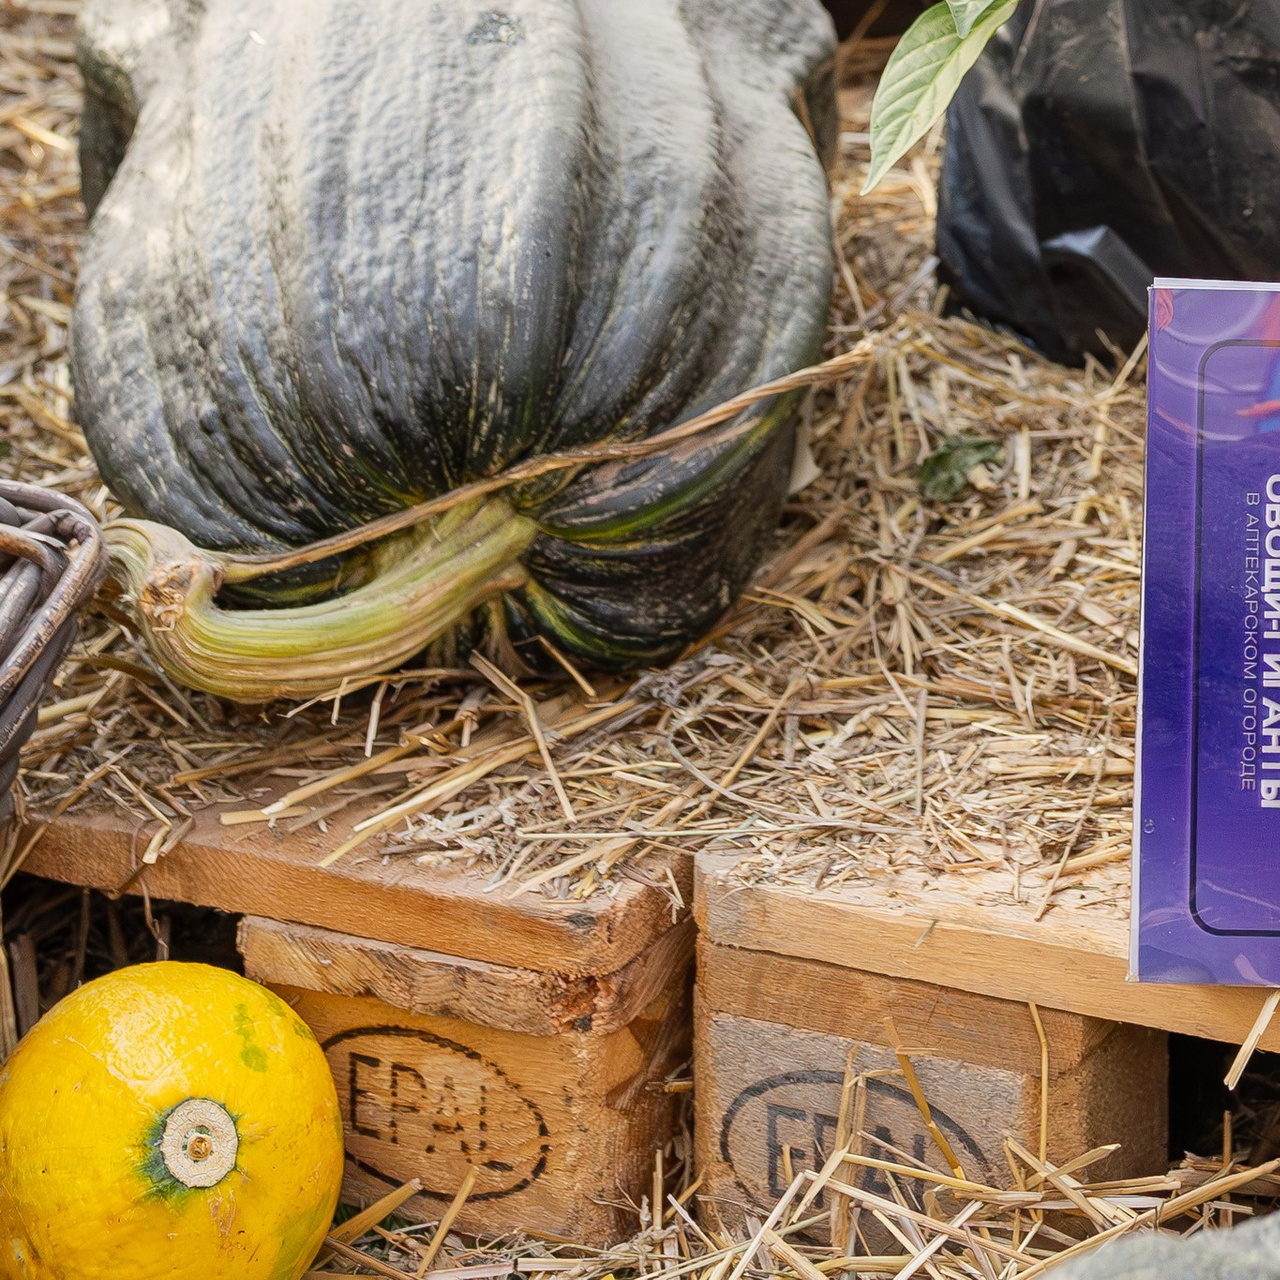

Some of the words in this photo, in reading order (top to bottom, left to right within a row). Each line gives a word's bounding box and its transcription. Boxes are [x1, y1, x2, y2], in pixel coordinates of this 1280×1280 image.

[1246, 493, 1260, 506] В
[1243, 513, 1260, 679] АПТЕКАРСКОМ
[1240, 688, 1257, 791] ОГОРОДЕ
